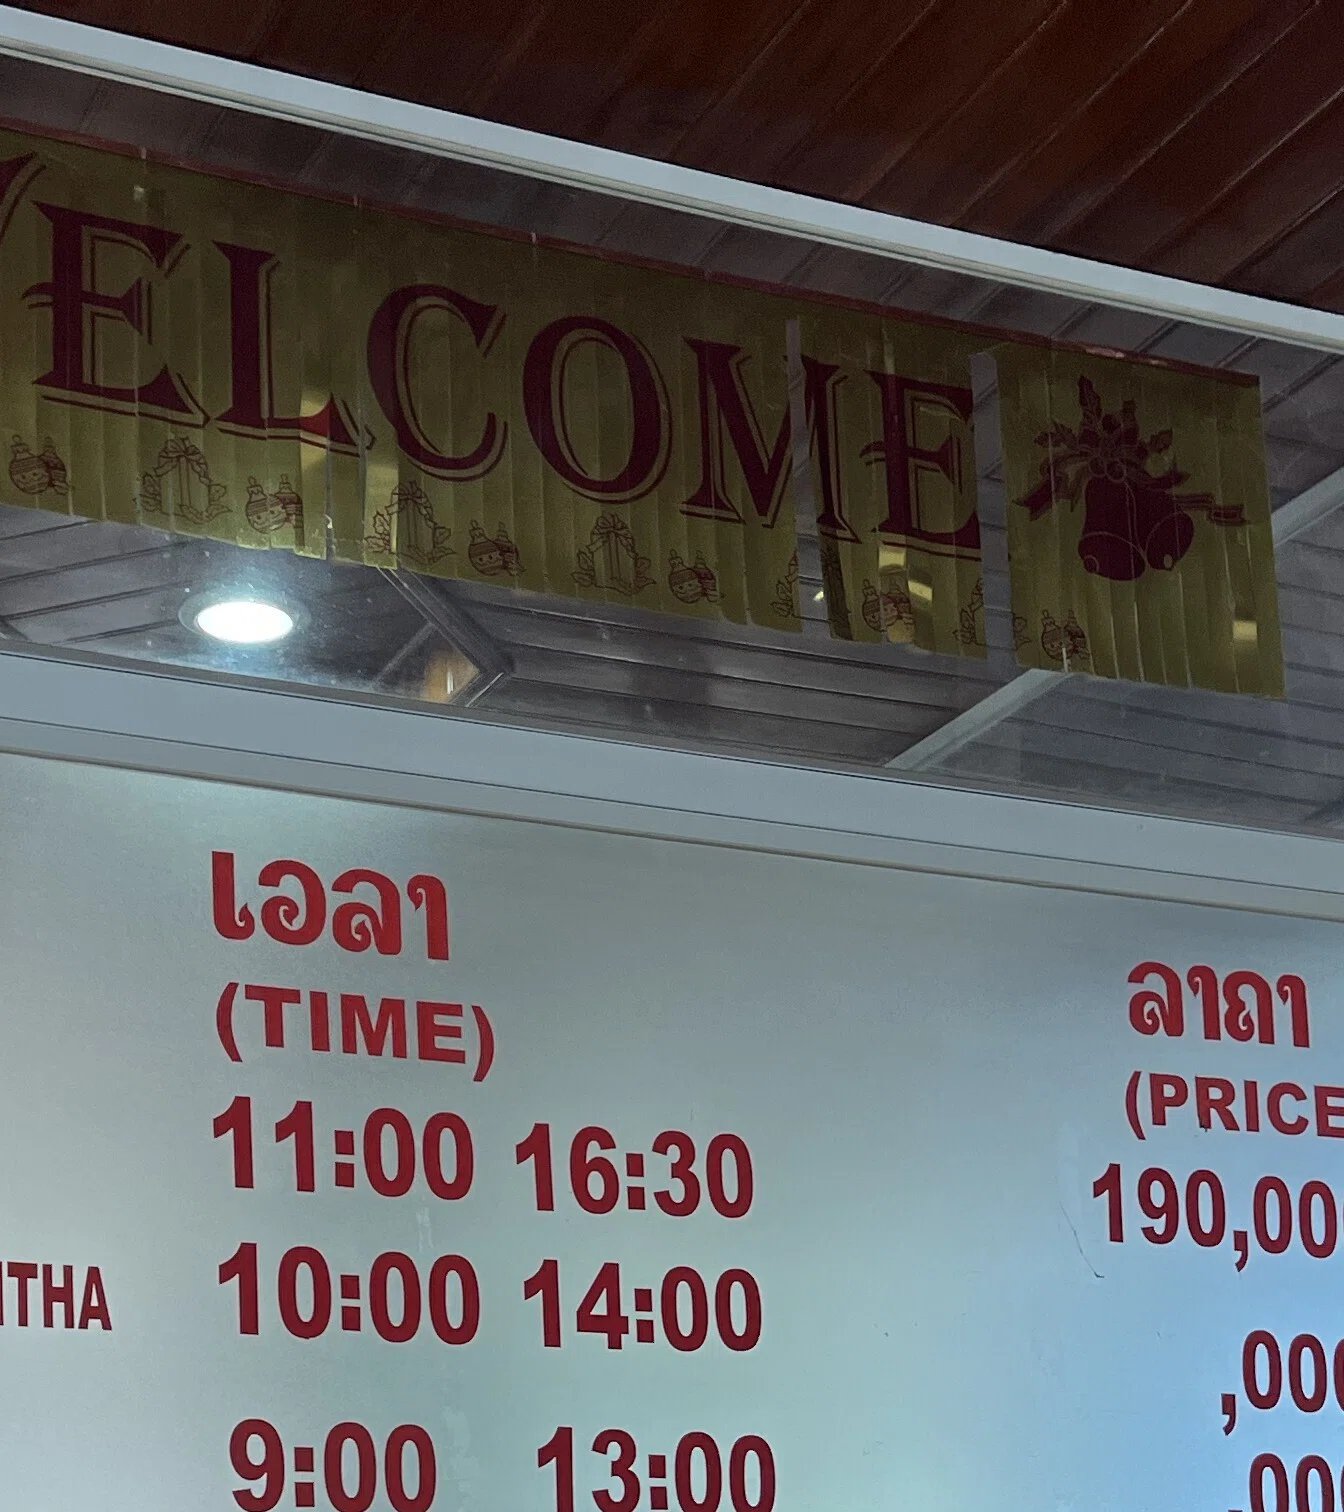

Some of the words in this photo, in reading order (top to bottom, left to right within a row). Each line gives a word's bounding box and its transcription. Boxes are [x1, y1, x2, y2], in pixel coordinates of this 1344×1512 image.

[210, 850, 451, 962] ເວລາ
[215, 981, 497, 1083] (TIME)
[1127, 960, 1312, 1049] ລາຄາ
[211, 1094, 476, 1201] 11:00
[513, 1121, 755, 1220] 16:30
[217, 1241, 482, 1346] 10:00
[522, 1258, 764, 1353] 14:00
